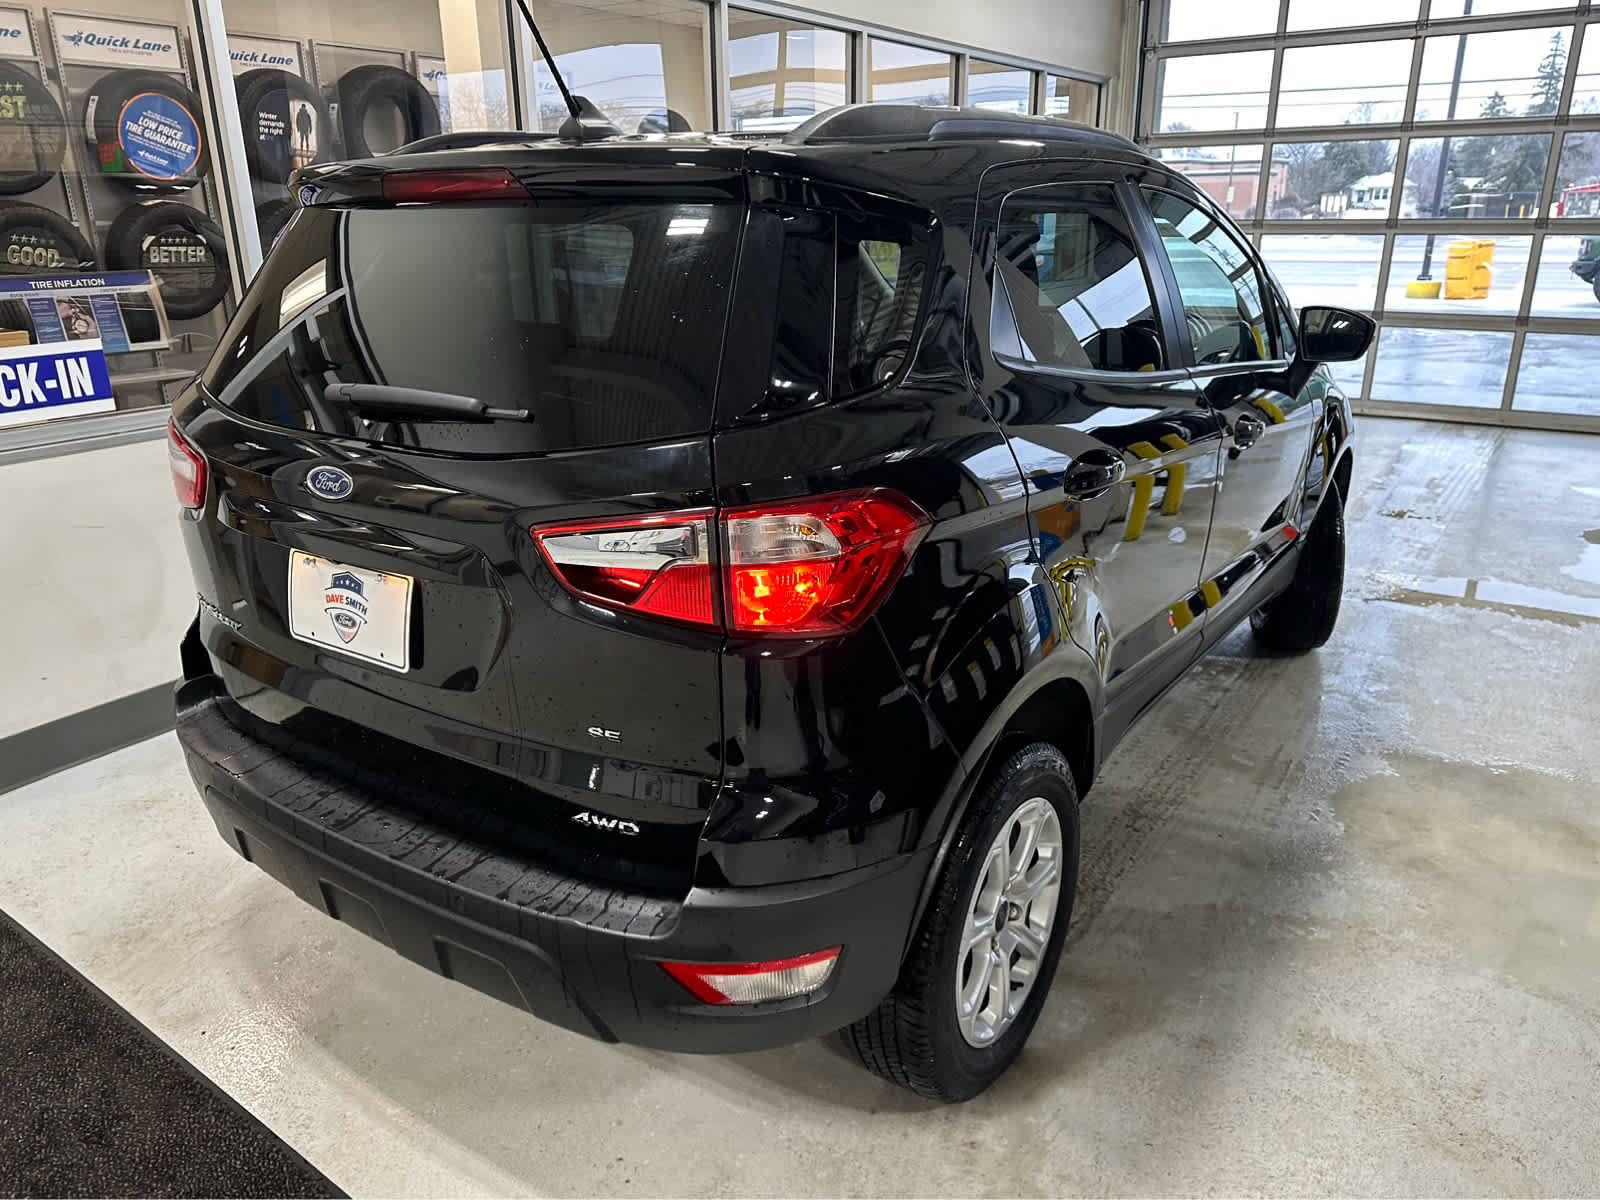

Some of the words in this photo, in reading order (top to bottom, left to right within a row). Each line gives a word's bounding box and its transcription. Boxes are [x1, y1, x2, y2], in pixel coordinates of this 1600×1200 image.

[84, 33, 130, 48] Quick
[132, 39, 172, 54] Lane
[227, 49, 259, 62] uick
[260, 53, 294, 65] Lane
[258, 111, 278, 120] Winter
[125, 120, 145, 136] TIRE
[143, 129, 194, 154] GUARANTEE
[138, 116, 159, 131] LOW
[159, 124, 184, 140] PRICE
[7, 245, 60, 268] GOOD
[150, 246, 206, 263] BETTER
[29, 281, 53, 289] TIRE
[54, 278, 105, 288] INFLATION
[0, 356, 95, 408] CK-IN
[315, 471, 349, 492] Ford
[325, 594, 344, 604] DAVE
[345, 596, 367, 615] SMITH
[587, 726, 622, 742] SE
[572, 811, 640, 836] AWD
